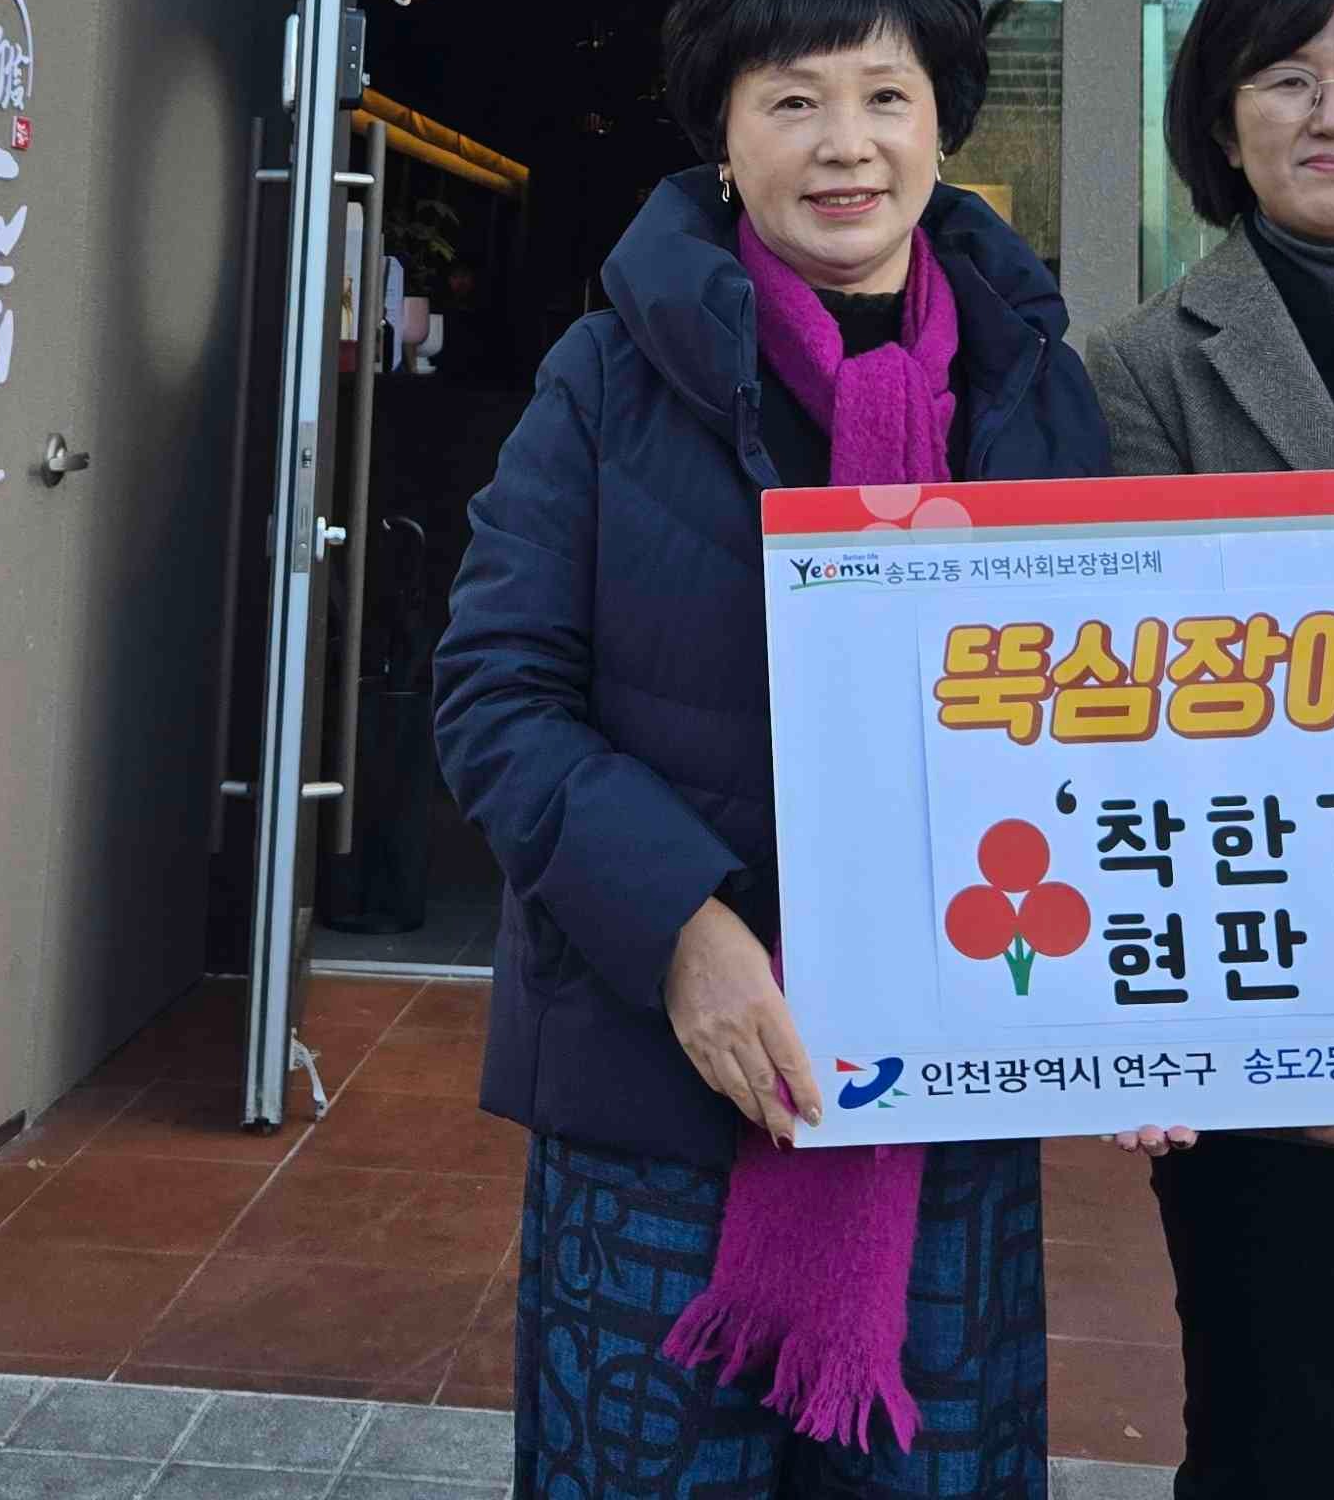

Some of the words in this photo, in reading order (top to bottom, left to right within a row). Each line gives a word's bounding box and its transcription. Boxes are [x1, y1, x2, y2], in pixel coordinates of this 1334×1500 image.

[789, 557, 880, 587] Yeonsu
[884, 560, 962, 584] 송도2동
[970, 550, 1162, 581] 지역사회보장협의체
[1103, 908, 1308, 1005] 현판
[921, 1055, 1101, 1097] 인천광역시
[1112, 1052, 1217, 1088] 연수구
